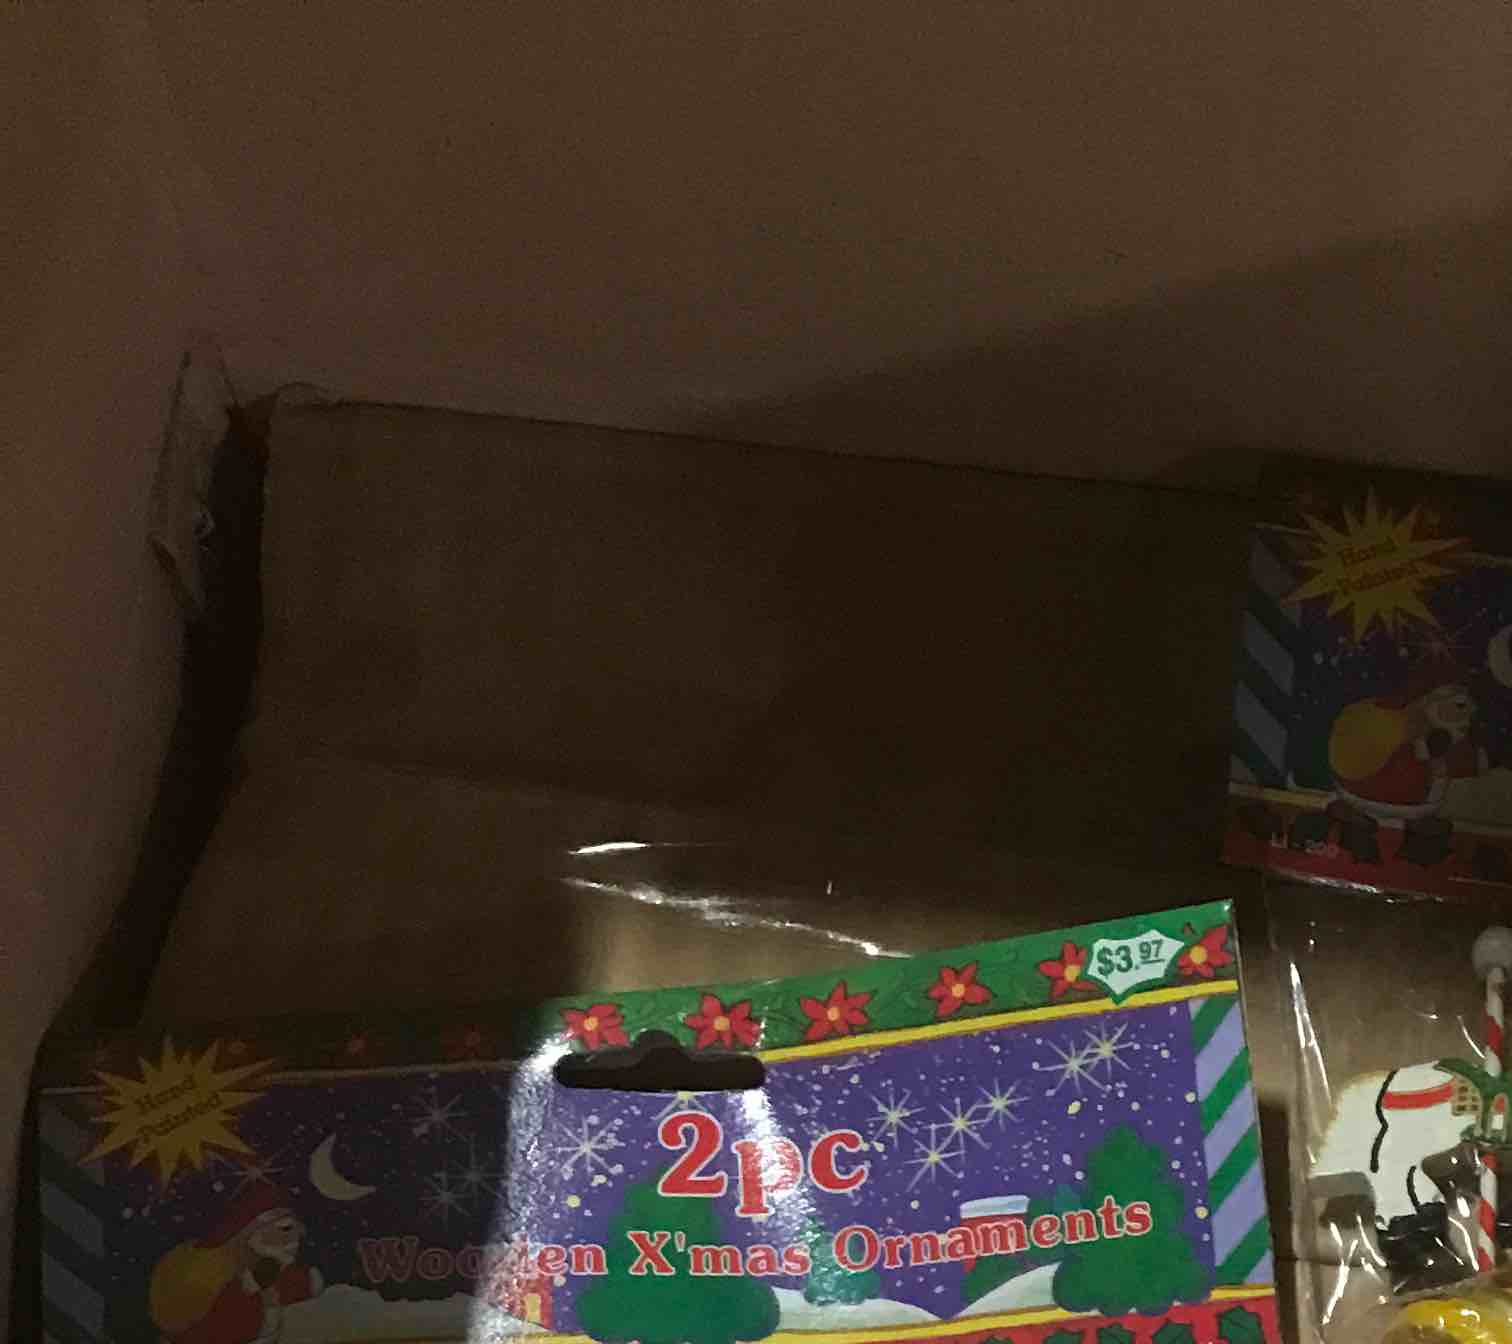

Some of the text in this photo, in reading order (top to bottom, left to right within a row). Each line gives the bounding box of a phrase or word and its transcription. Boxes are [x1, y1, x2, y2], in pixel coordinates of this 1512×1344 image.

[1096, 939, 1164, 976] $3.97
[657, 1110, 870, 1217] 2pc
[627, 1230, 811, 1276] X'mas
[833, 1194, 1153, 1273] Ornaments
